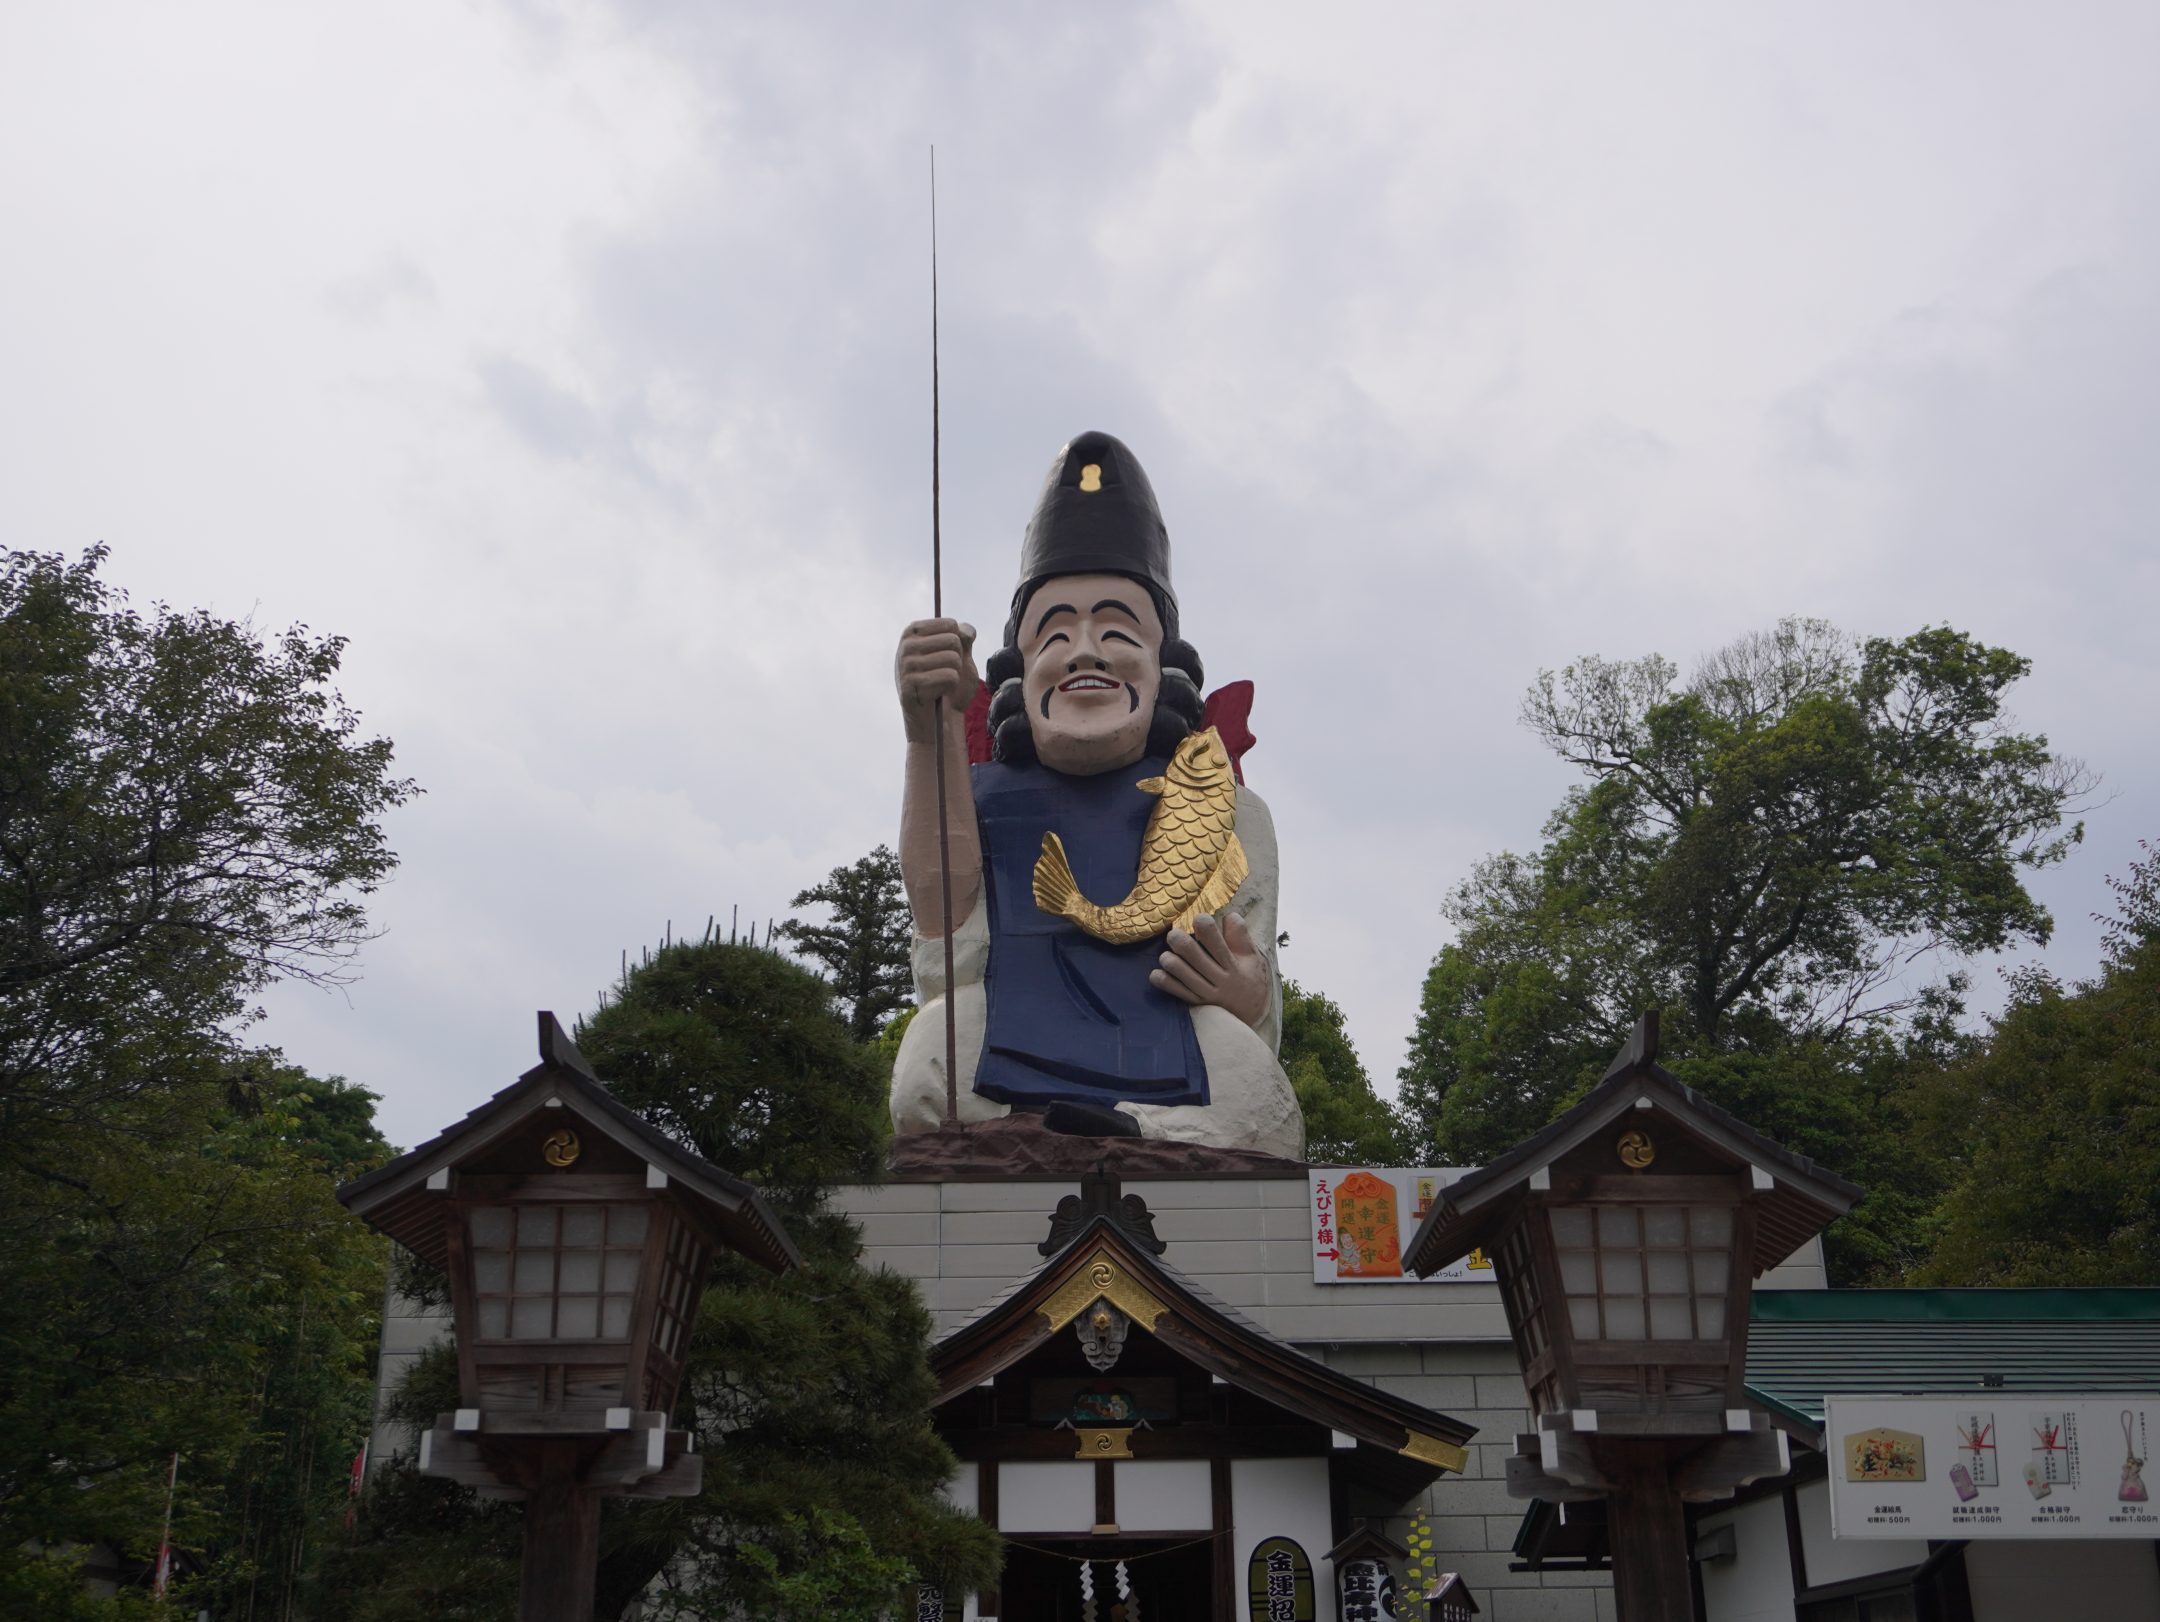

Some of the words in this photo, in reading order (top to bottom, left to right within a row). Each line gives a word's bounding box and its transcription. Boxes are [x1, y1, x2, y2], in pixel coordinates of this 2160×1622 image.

[1316, 1180, 1333, 1244] えびす様
[1267, 1549, 1295, 1622] 金運招
